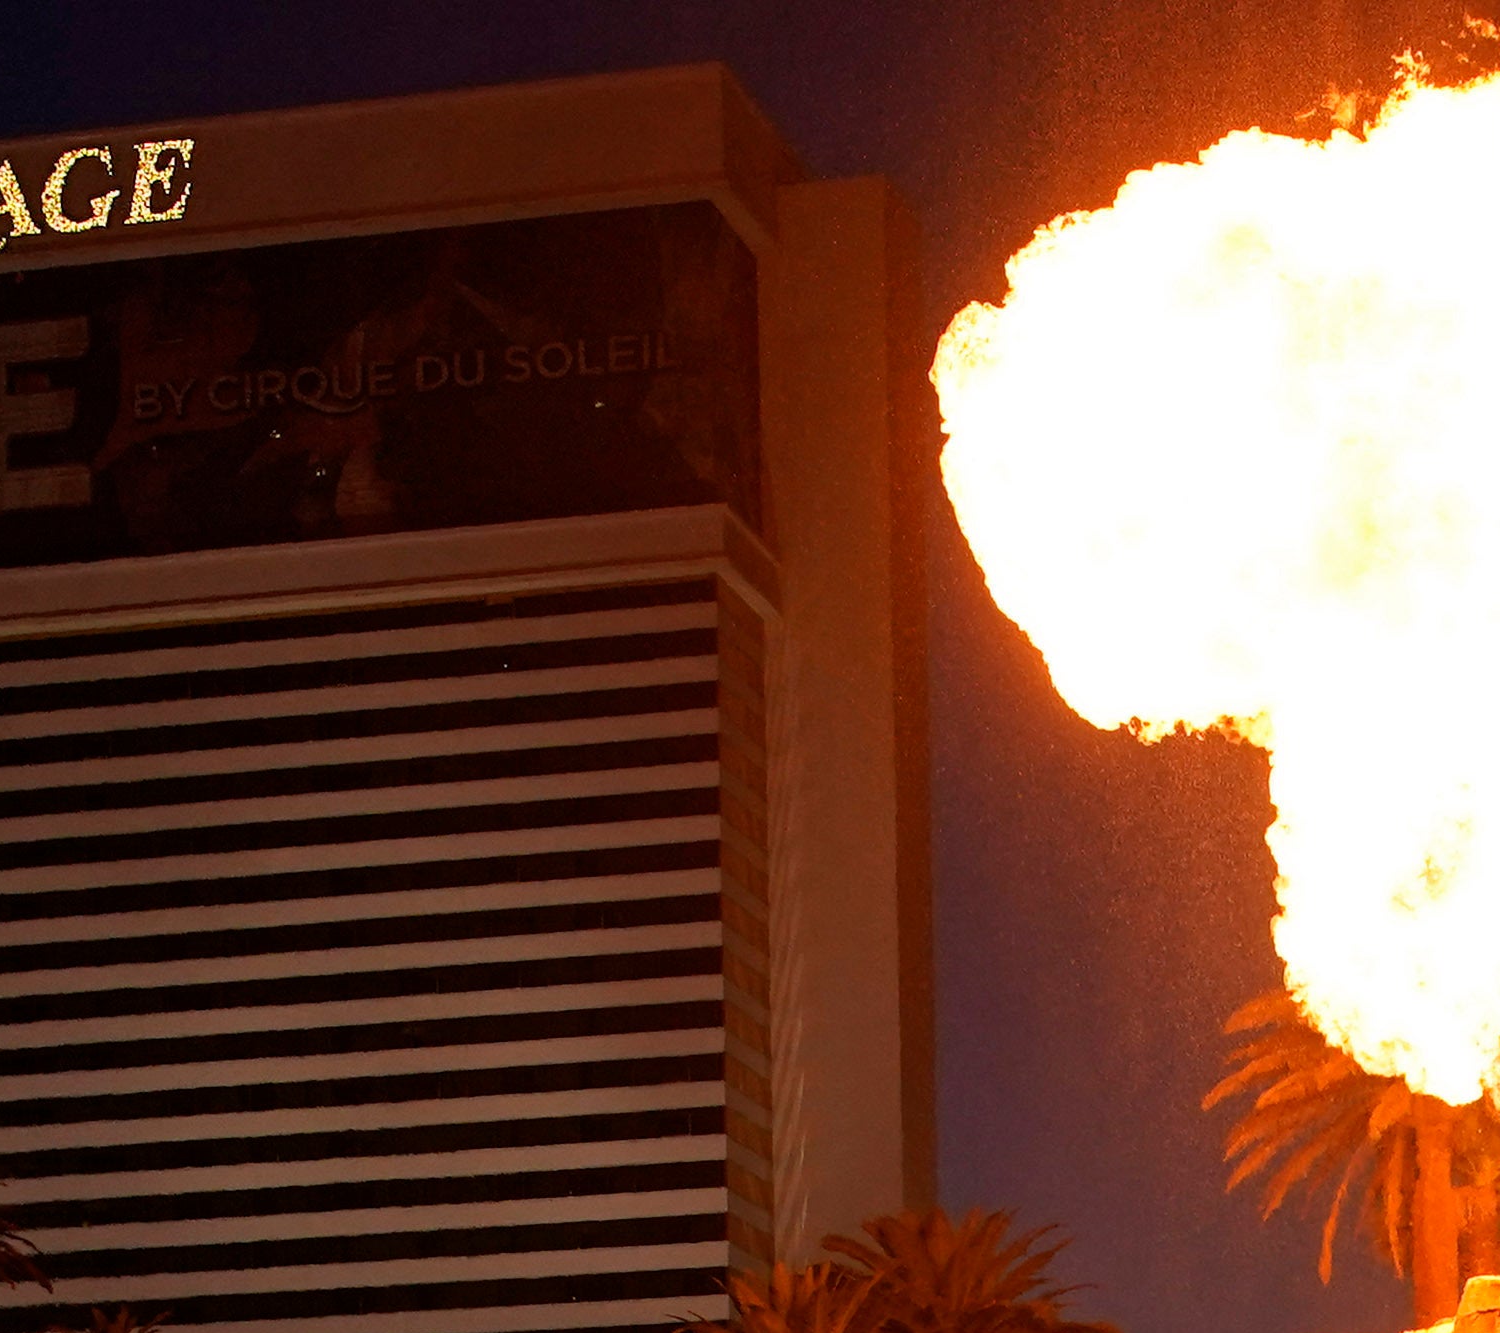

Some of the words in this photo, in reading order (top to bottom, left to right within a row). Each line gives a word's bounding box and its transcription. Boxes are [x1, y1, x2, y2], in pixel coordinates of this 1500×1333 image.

[133, 379, 194, 420] BY
[207, 358, 397, 415] CIRQUE
[414, 349, 485, 394] DU
[505, 333, 677, 384] SOLEIL
